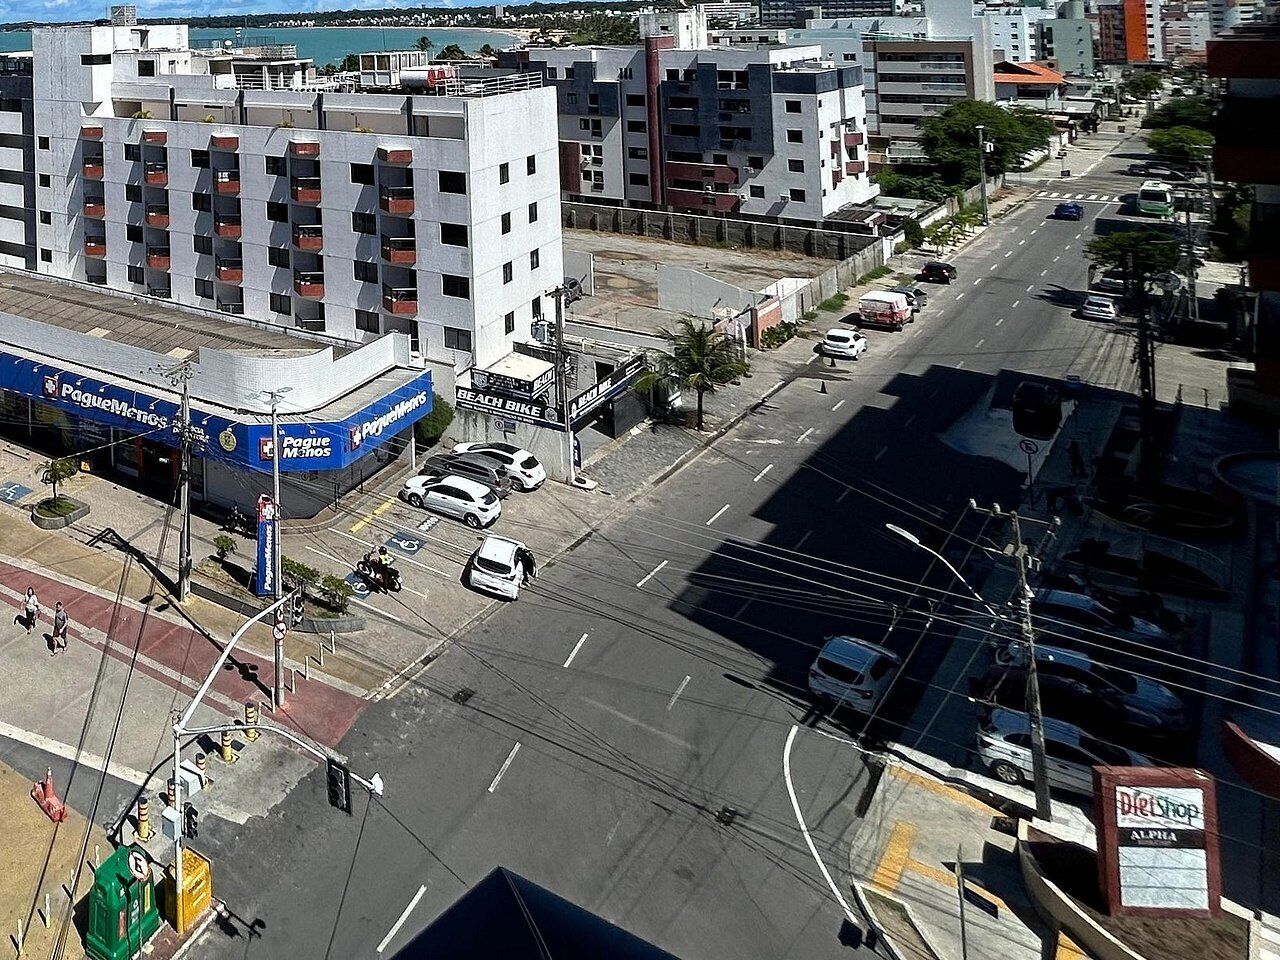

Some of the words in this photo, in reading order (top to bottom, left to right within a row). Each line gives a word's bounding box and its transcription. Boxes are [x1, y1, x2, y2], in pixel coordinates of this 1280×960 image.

[61, 383, 168, 430] PagueMenos
[457, 389, 504, 409] BEACH
[505, 399, 542, 417] BIKE
[362, 391, 428, 439] PagueMenos
[282, 436, 331, 449] Pague
[282, 446, 332, 458] Menos
[1130, 829, 1178, 841] ALPHA
